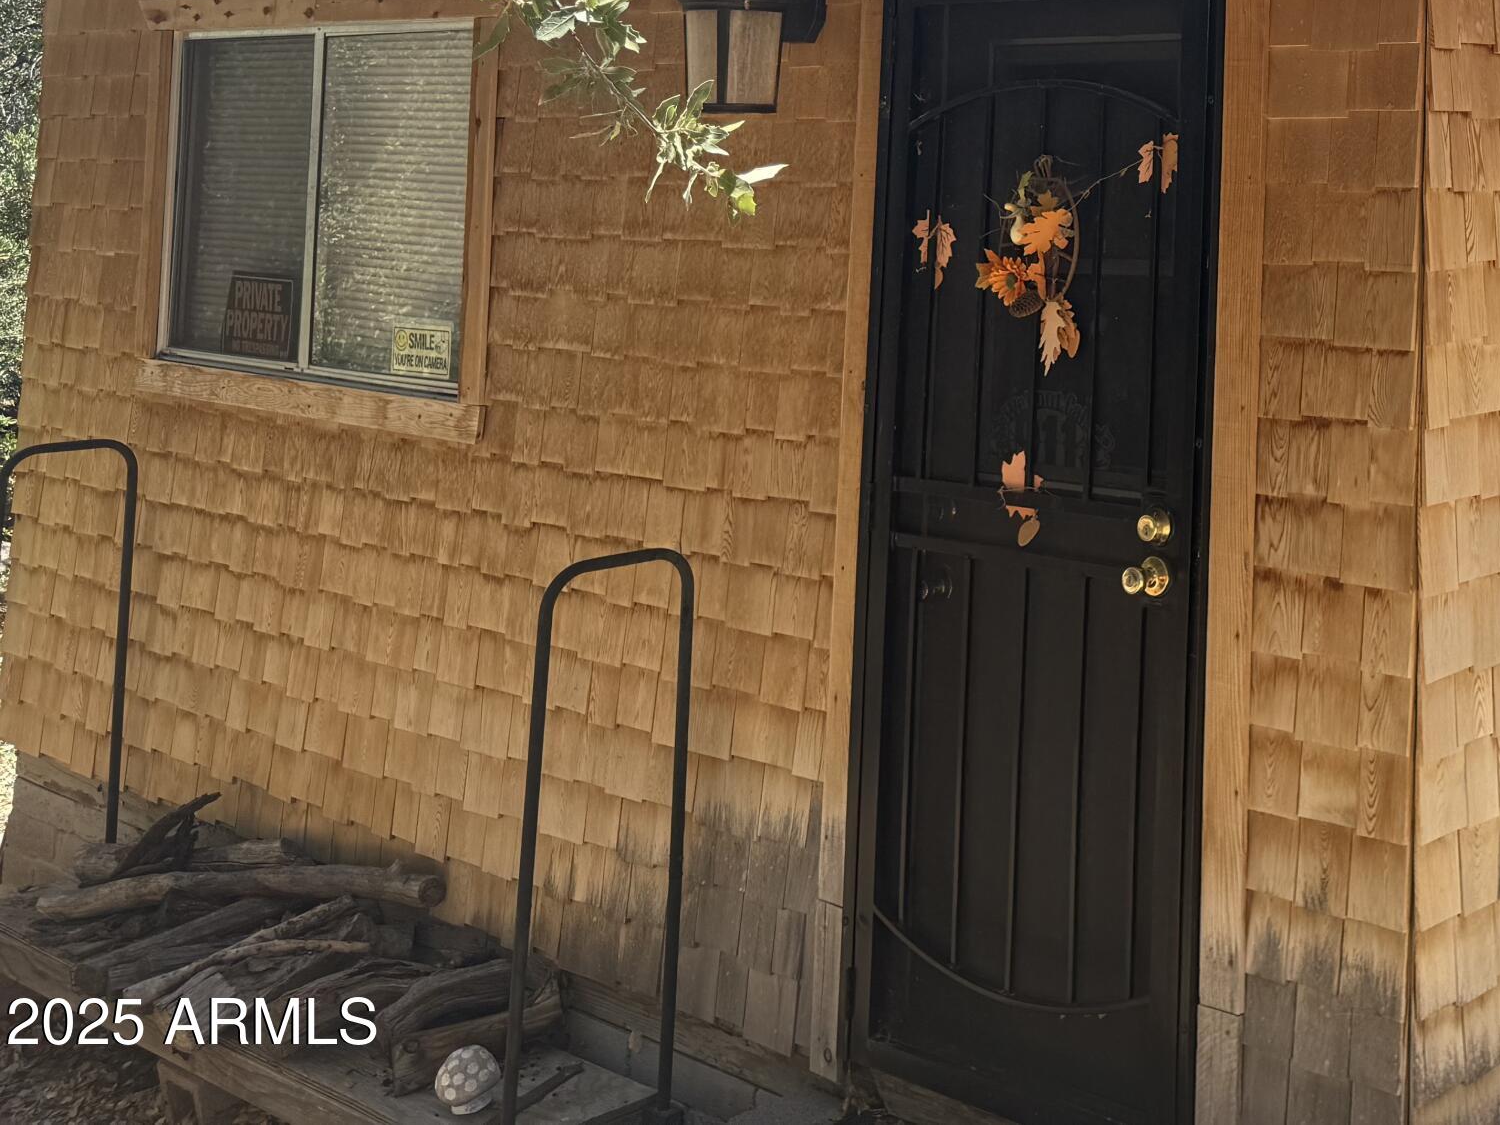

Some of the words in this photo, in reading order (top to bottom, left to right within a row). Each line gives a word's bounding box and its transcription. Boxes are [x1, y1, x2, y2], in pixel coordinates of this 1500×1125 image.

[235, 280, 282, 312] PRIVATE
[226, 309, 289, 342] PROPERTY
[408, 333, 435, 350] SMILE
[415, 355, 424, 368] ON
